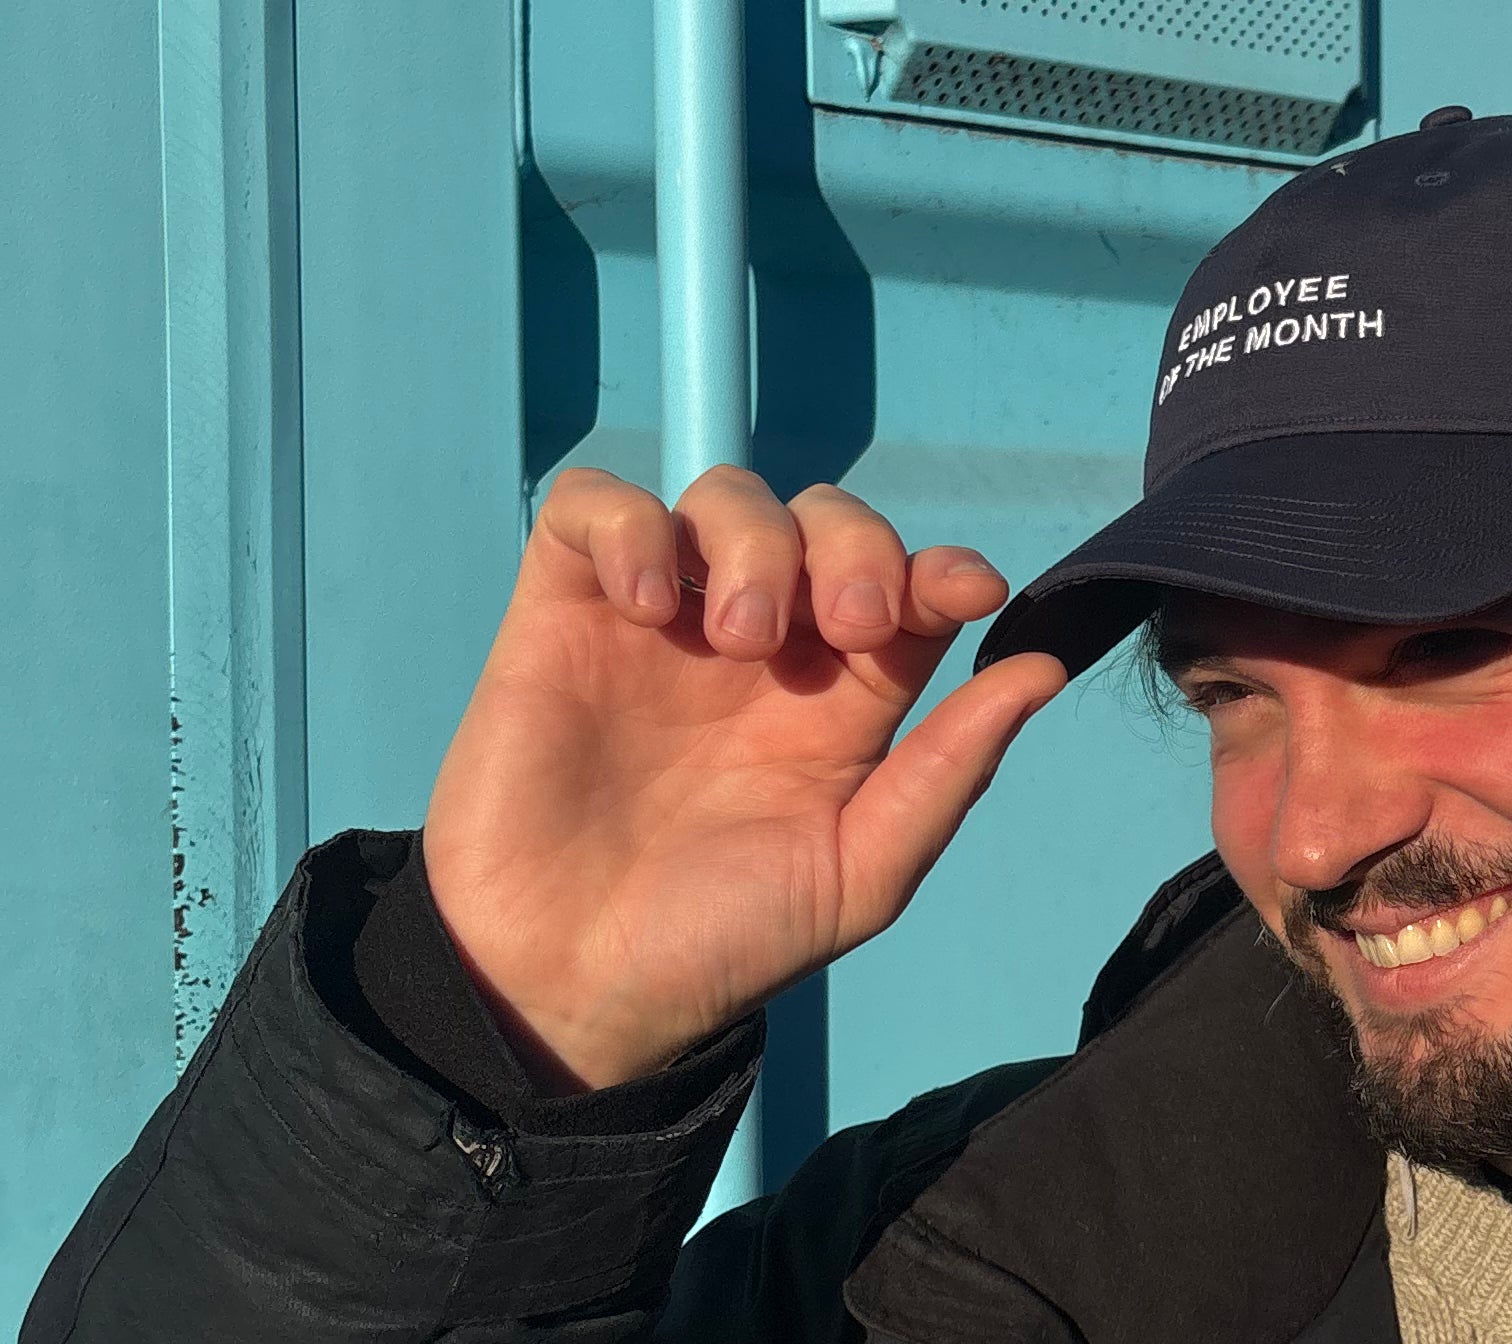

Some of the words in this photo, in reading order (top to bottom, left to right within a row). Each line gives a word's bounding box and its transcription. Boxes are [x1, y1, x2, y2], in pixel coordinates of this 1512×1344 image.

[1178, 274, 1349, 352] EMPLOYEE
[1184, 335, 1236, 378] THE
[1243, 309, 1384, 354] MONTH
